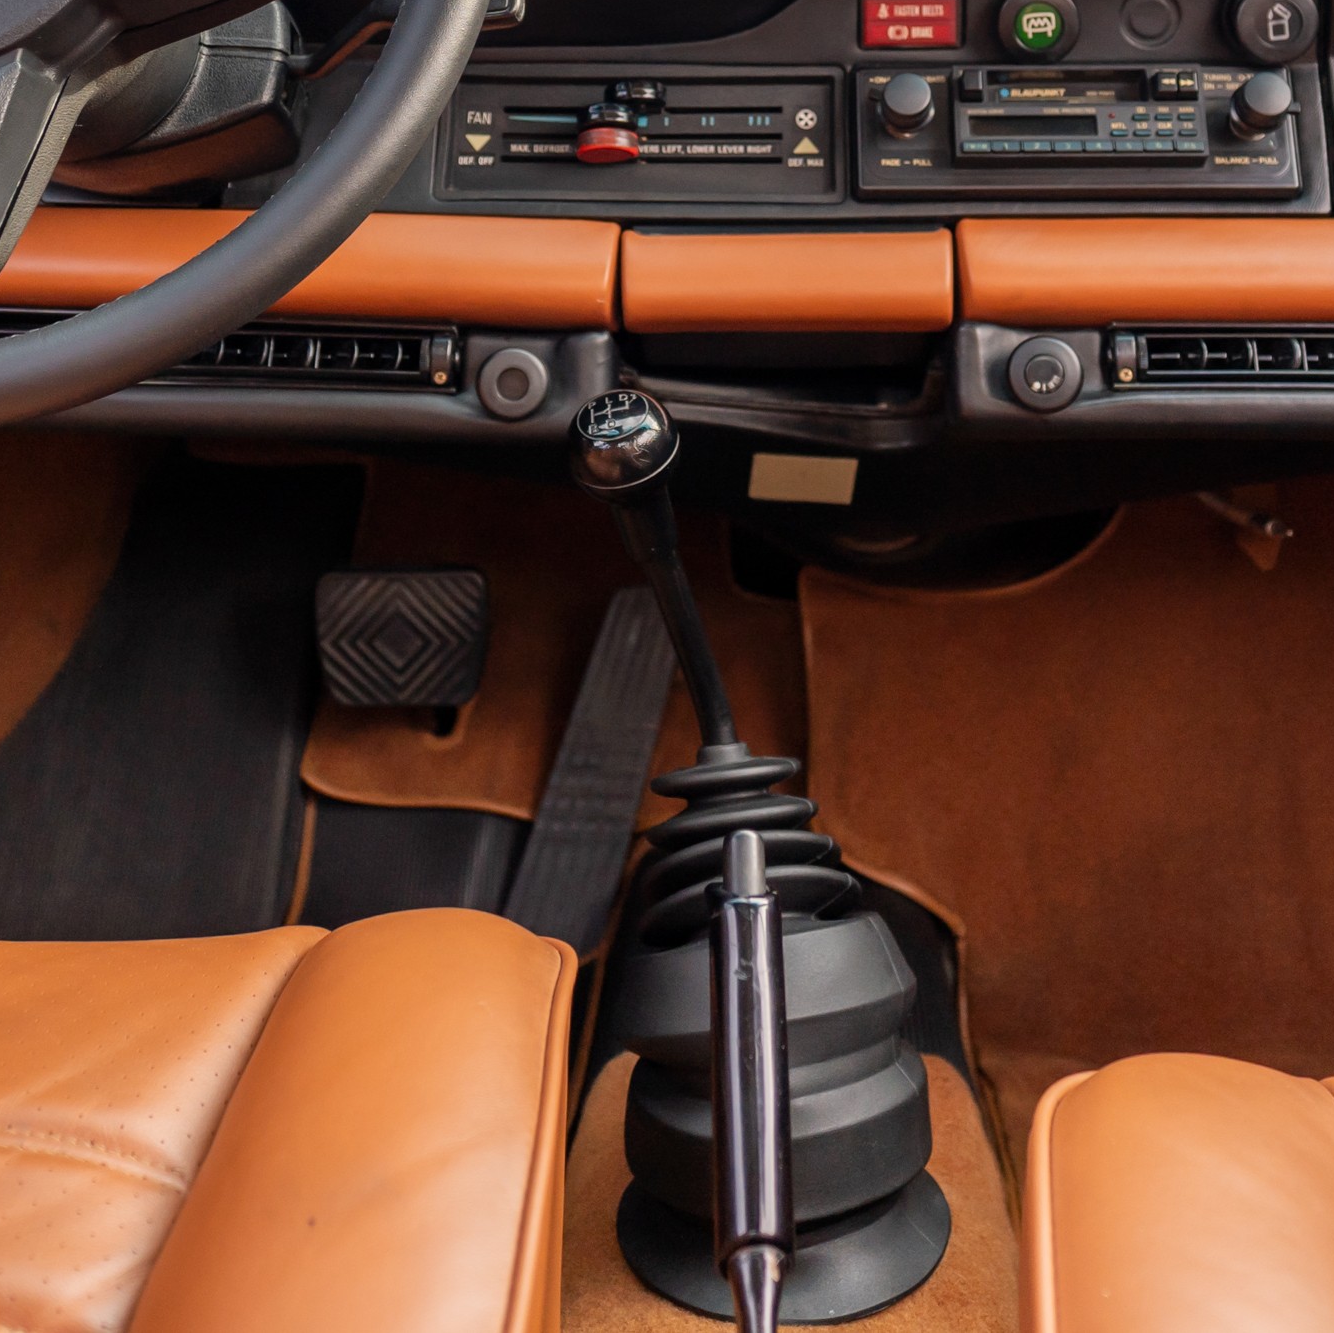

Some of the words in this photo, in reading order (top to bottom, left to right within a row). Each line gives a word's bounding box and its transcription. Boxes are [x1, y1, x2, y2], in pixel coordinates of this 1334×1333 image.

[921, 4, 945, 17] BELTS
[910, 26, 934, 39] BRAKE
[1010, 88, 1067, 97] BLAUPUNKT
[467, 111, 493, 125] FAN
[638, 144, 661, 154] VERS
[661, 144, 686, 155] LEFT,
[686, 144, 716, 154] LOWER
[717, 144, 745, 154] LEVER
[746, 144, 772, 155] RIGHT
[478, 156, 494, 166] OFF
[1213, 155, 1250, 165] BALANCE
[1258, 155, 1280, 166] PULL
